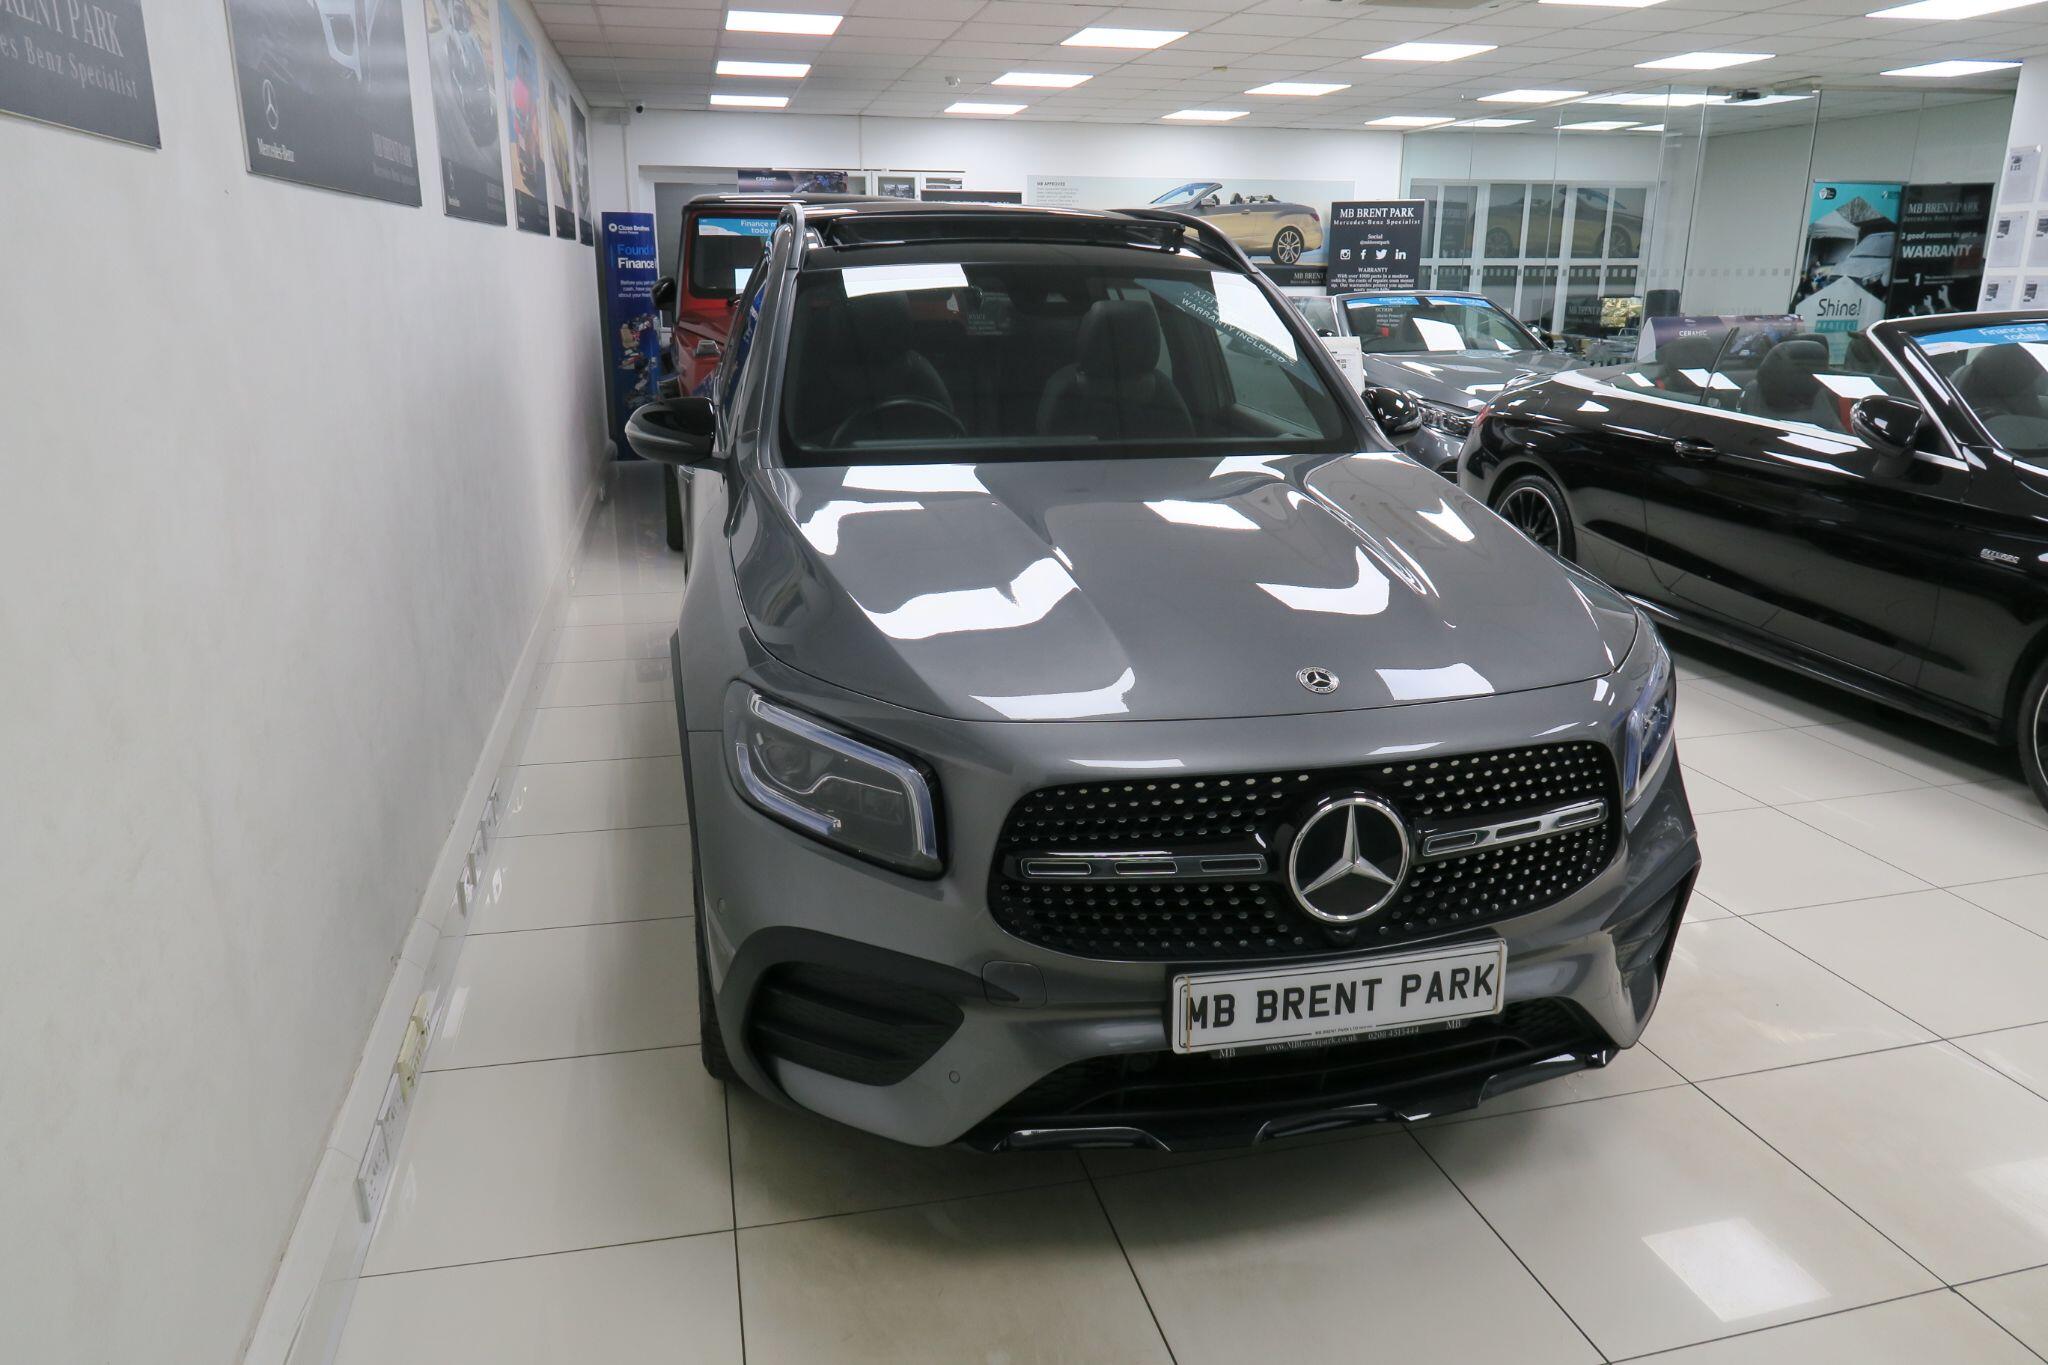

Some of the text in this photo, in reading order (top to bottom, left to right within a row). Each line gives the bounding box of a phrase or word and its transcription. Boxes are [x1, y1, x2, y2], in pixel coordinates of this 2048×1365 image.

[67, 0, 124, 58] PARK
[23, 35, 64, 75] Benz
[68, 52, 138, 100] Specialist
[1340, 207, 1415, 218] MB BRENT PARK
[1907, 204, 1923, 214] MB
[1902, 244, 1972, 258] WARRANTY
[1181, 298, 1236, 332] WARRANTY
[1817, 298, 1862, 317] Shine!
[1679, 329, 1708, 337] CERAMIC
[1235, 329, 1288, 364] INCLUDED
[1186, 963, 1495, 1031] MB BRENT PARK
[1446, 1019, 1462, 1030] MB
[1219, 1048, 1236, 1058] MB
